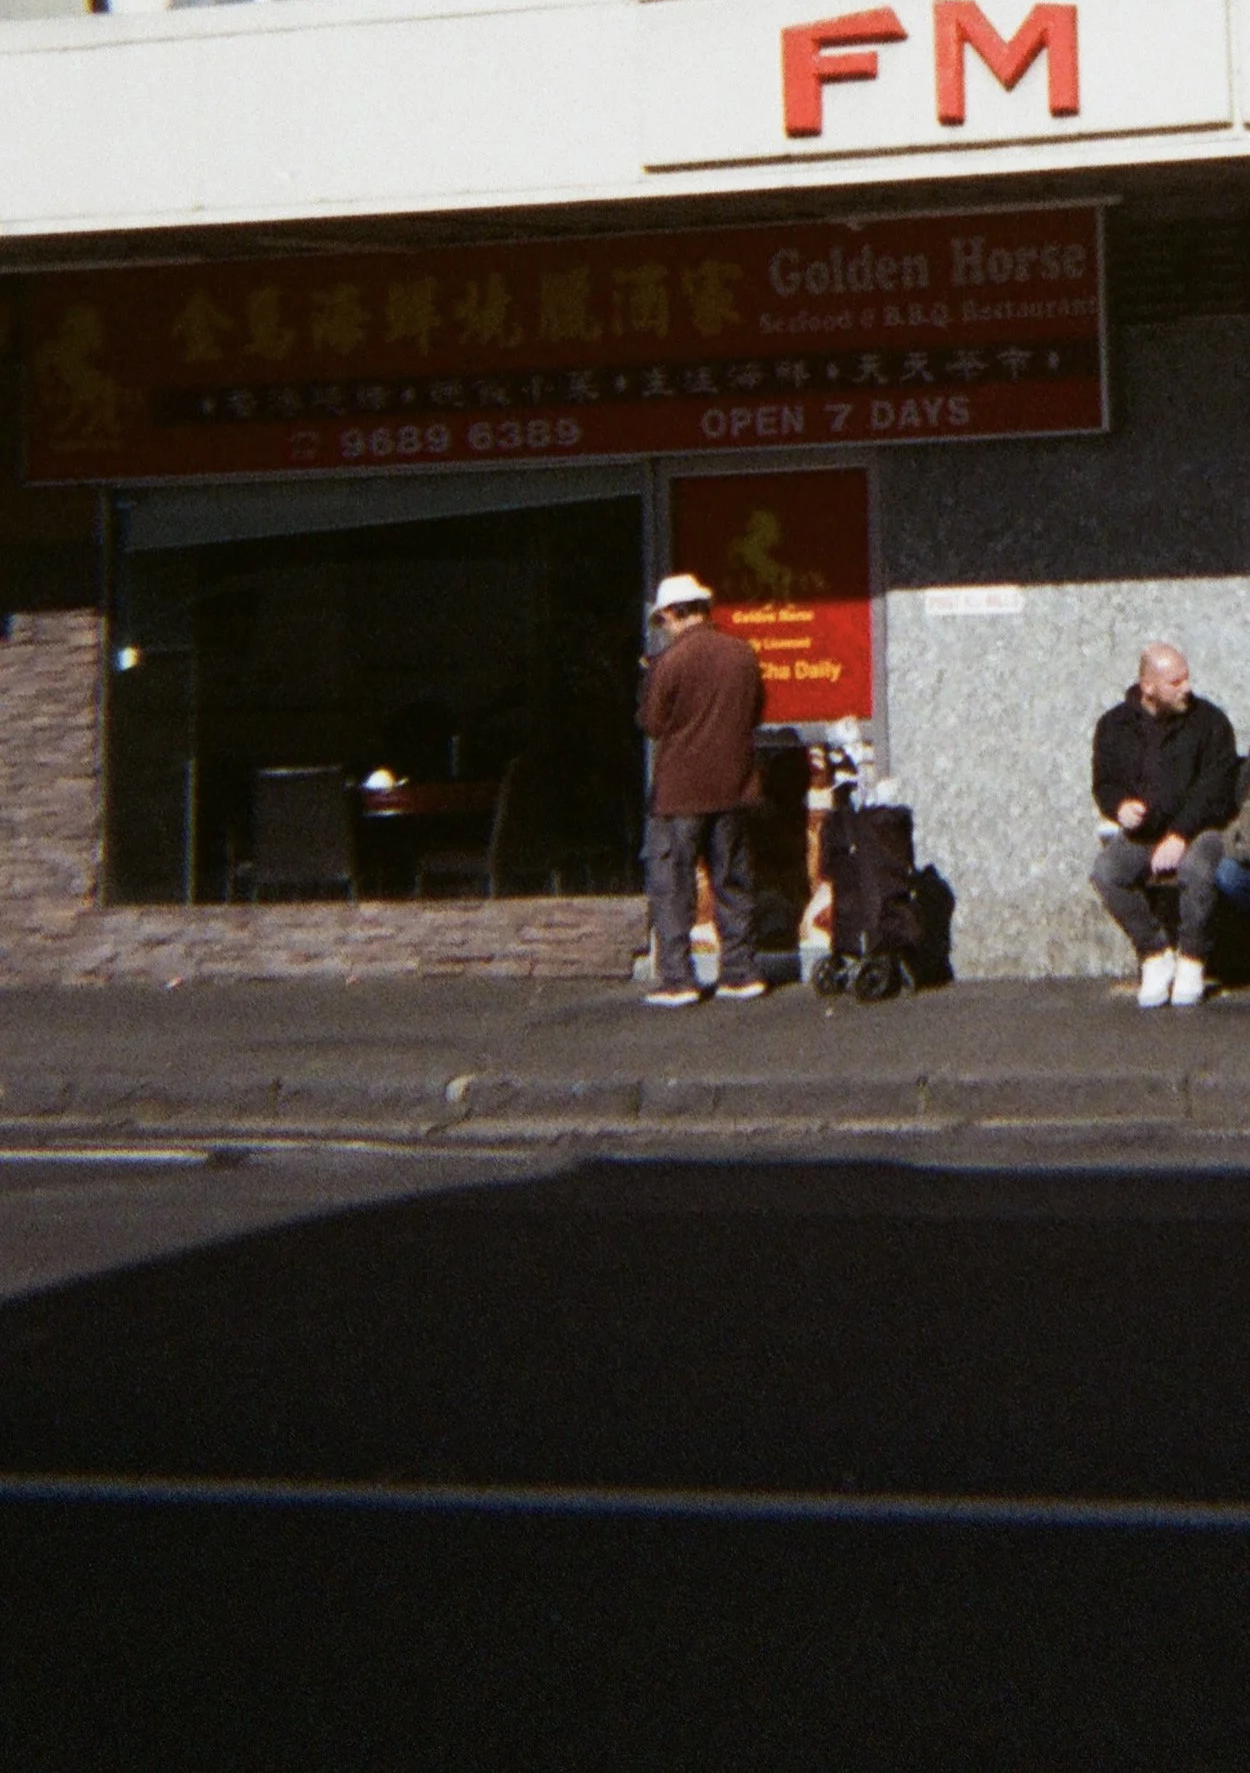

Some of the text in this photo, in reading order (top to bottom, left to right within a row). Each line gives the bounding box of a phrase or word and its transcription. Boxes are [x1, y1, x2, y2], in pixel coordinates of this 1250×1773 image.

[769, 235, 1087, 297] Golden Horse
[758, 309, 853, 335] Seafood
[337, 416, 584, 460] 9689 6389
[700, 394, 971, 441] OPEN 7 DAYS
[794, 658, 843, 683] Daily
